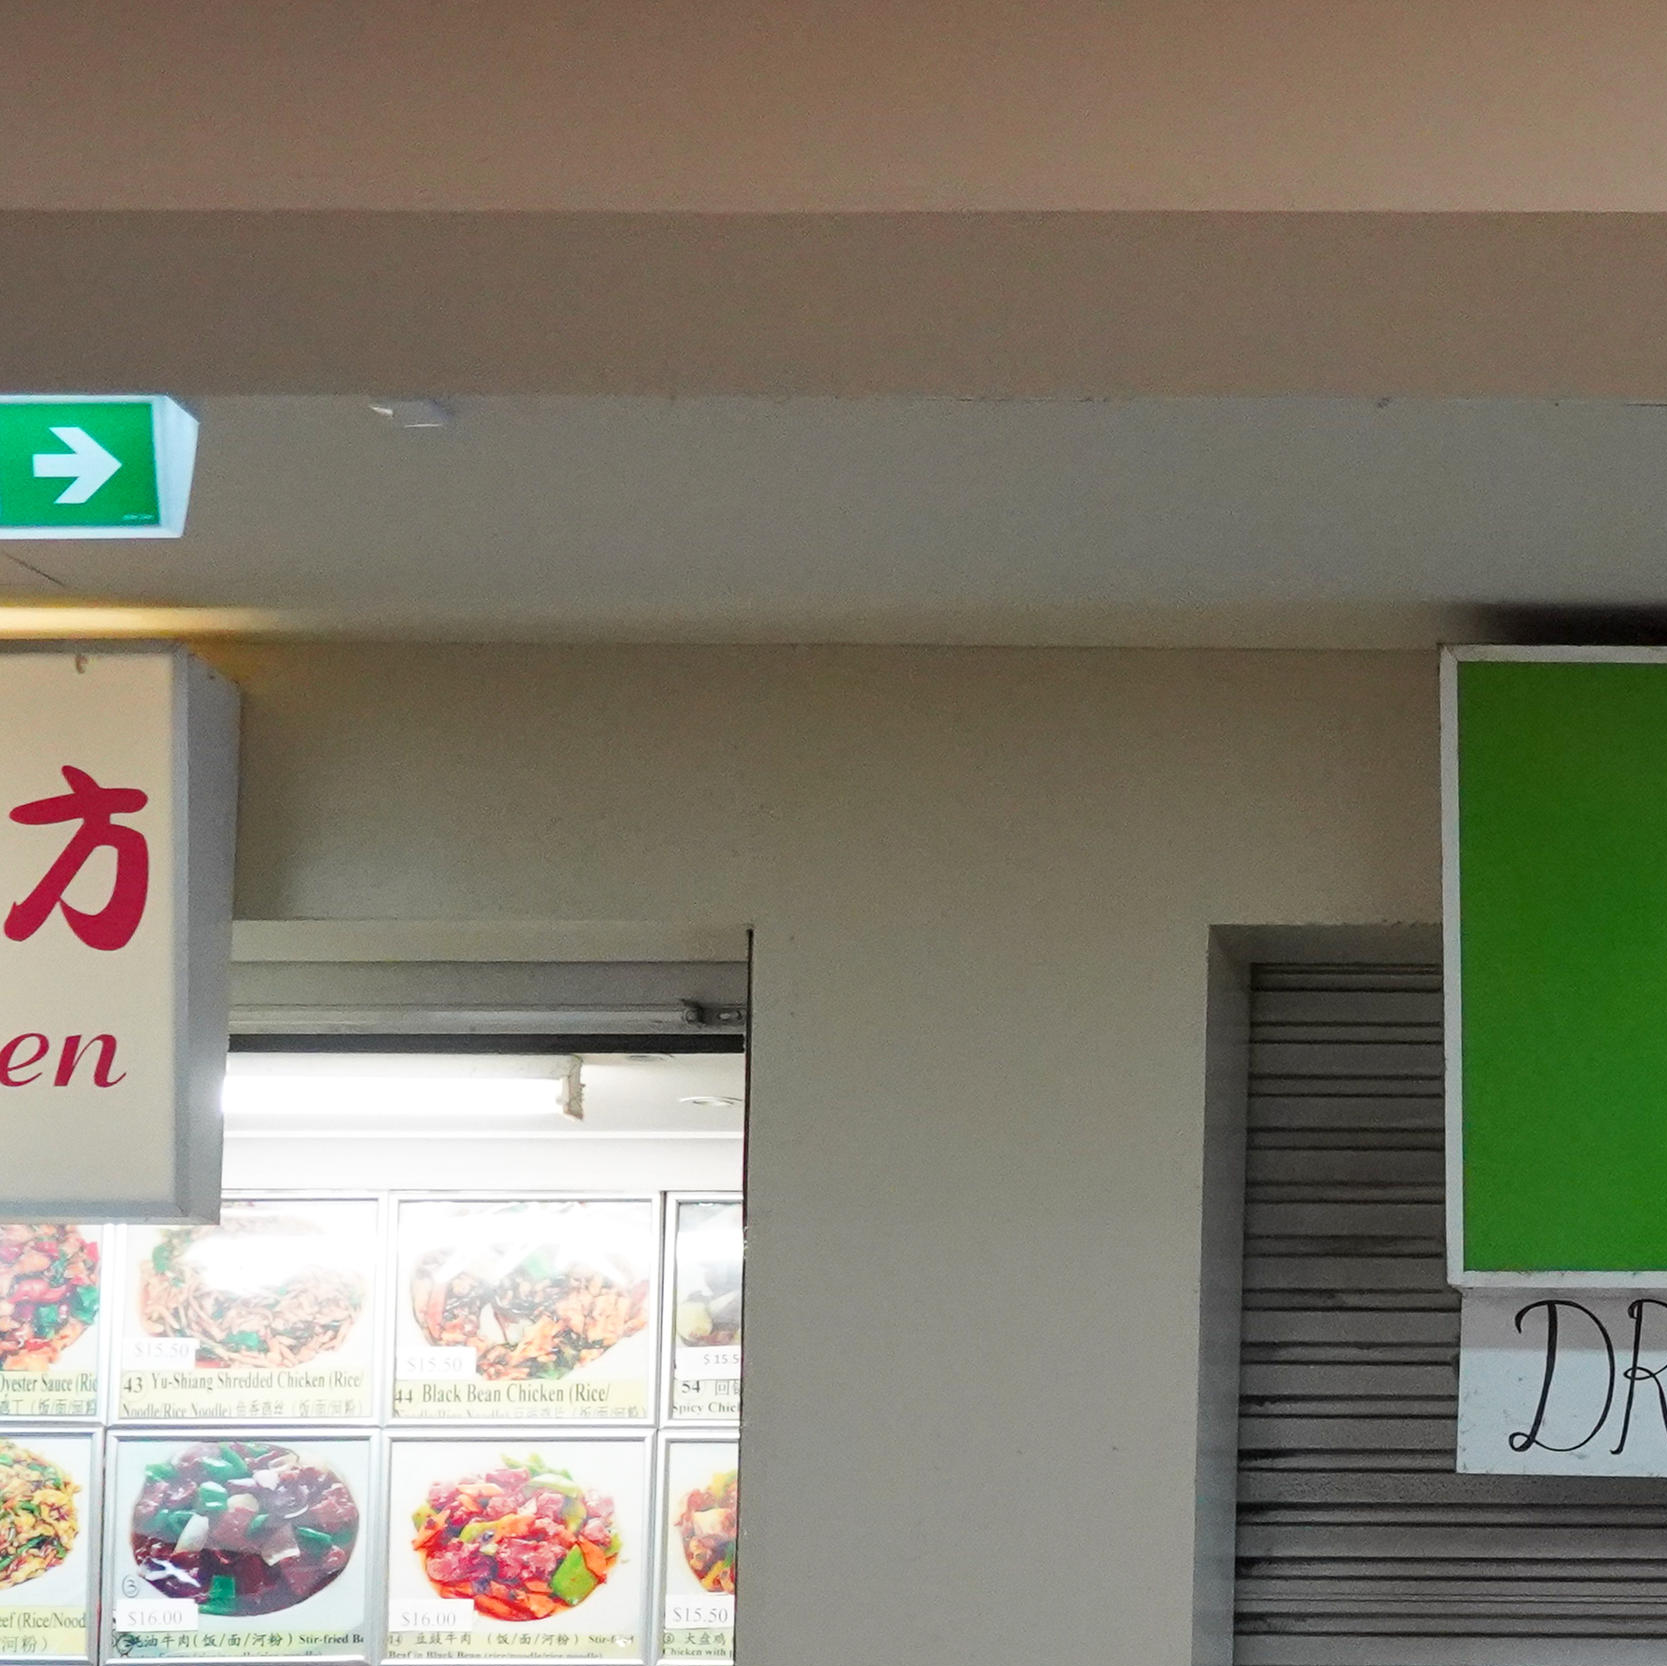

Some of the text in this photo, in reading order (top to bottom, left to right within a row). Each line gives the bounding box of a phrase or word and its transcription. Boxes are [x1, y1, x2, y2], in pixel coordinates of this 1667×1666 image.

[3, 765, 149, 951] 方
[134, 1343, 190, 1358] $15.50
[407, 1356, 463, 1372] $15.50
[41, 1373, 73, 1393] Sauce
[122, 1376, 144, 1393] 43
[152, 1371, 214, 1392] Yu-Shiang
[217, 1371, 273, 1389] Shredded
[277, 1371, 325, 1389] Chicken
[681, 1380, 700, 1394] 54
[422, 1383, 461, 1403] Black
[467, 1383, 502, 1403] Bean
[506, 1383, 564, 1403] Chicken
[128, 1610, 183, 1626] $16.00
[401, 1610, 456, 1627] $16.00
[673, 1607, 728, 1623] $15.50
[298, 1632, 349, 1644] Stir-fried
[684, 1631, 726, 1646] 大盘鸡
[705, 1648, 726, 1657] with
